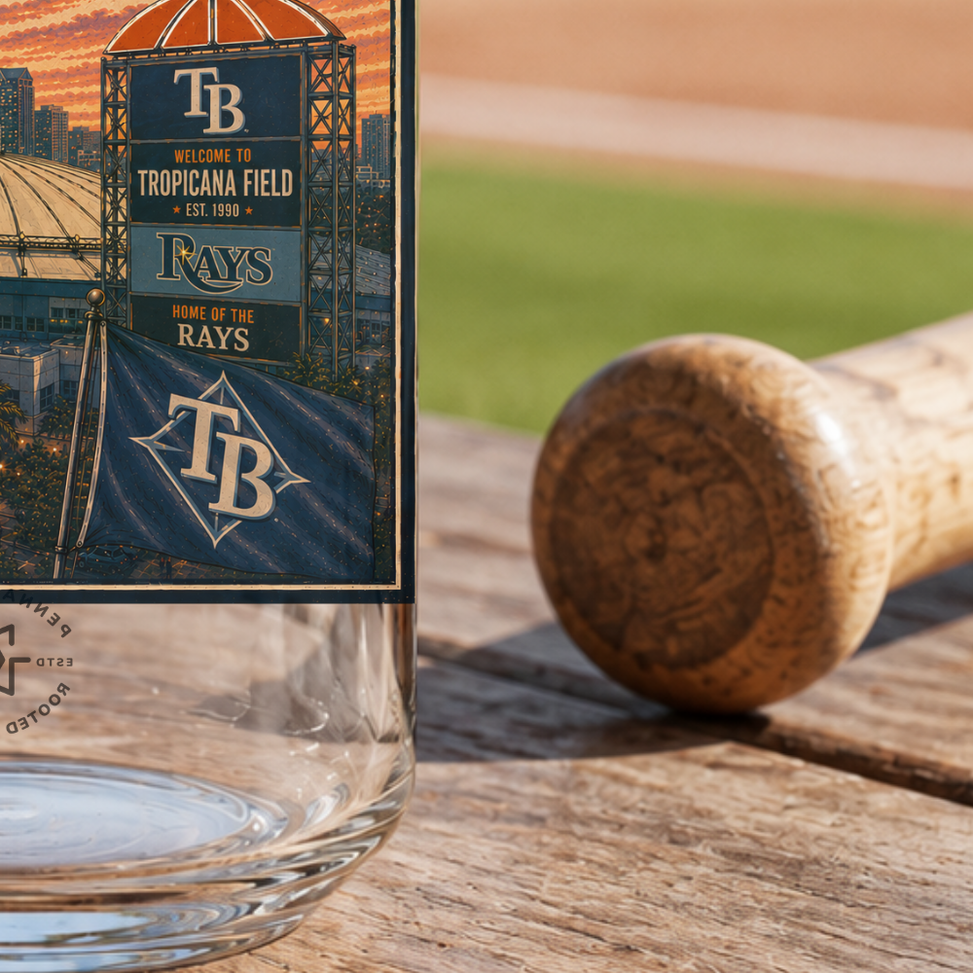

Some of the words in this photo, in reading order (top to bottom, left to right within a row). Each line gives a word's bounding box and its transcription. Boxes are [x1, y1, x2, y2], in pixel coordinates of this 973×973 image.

[173, 66, 246, 134] TB
[174, 148, 231, 164] WELCOME
[236, 147, 252, 163] TO
[137, 169, 237, 197] TROPICANA
[243, 169, 293, 197] FIELD
[186, 203, 208, 218] EST.
[212, 203, 240, 218] 1990
[172, 304, 207, 321] HOME
[211, 306, 227, 322] OF
[230, 308, 255, 324] THE
[177, 323, 250, 352] RAYS
[168, 393, 276, 520] TB
